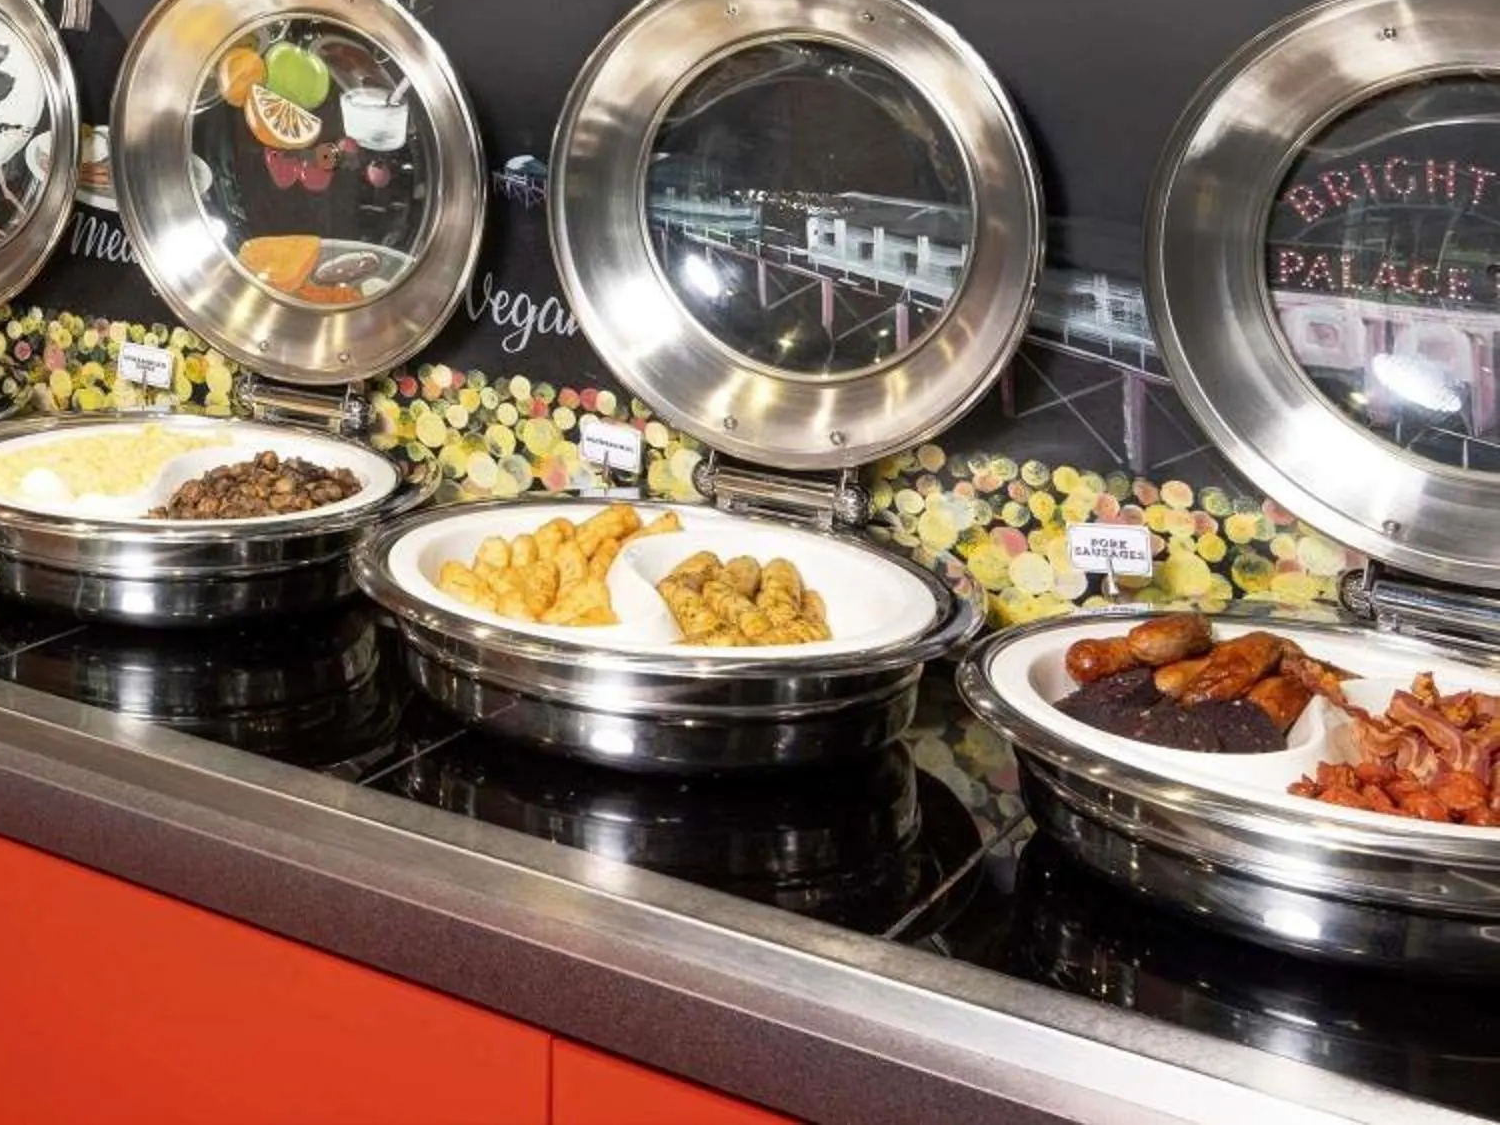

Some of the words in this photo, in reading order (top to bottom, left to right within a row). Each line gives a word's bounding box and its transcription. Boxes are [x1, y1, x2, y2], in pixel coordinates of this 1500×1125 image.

[1285, 156, 1499, 223] BRIGHT
[1279, 249, 1473, 302] PALACE
[1075, 546, 1145, 560] SAUSAGES
[1091, 538, 1128, 549] PORK
